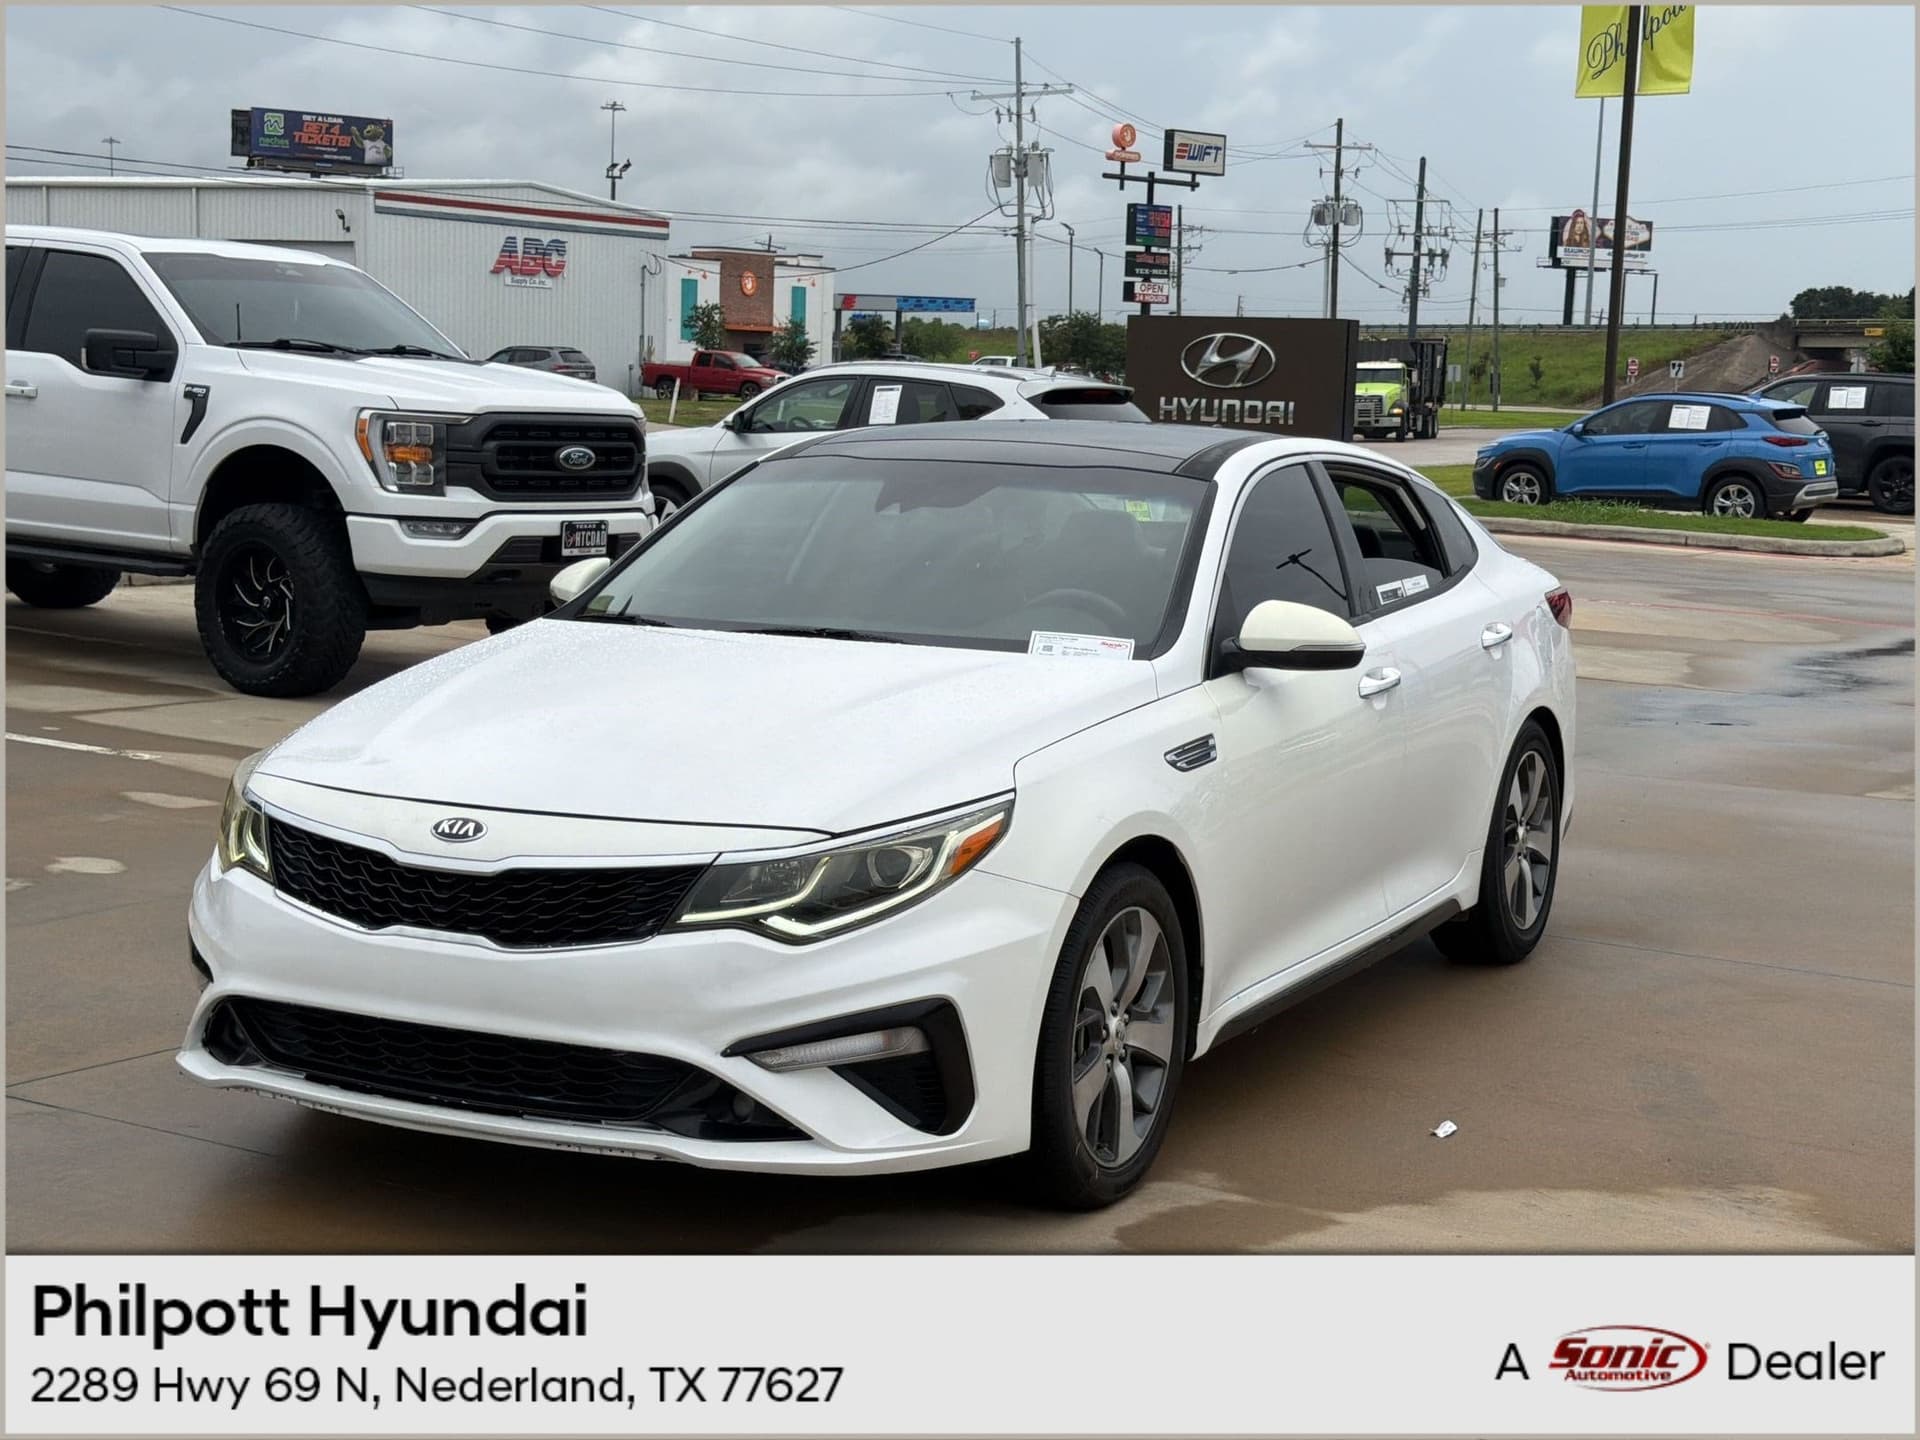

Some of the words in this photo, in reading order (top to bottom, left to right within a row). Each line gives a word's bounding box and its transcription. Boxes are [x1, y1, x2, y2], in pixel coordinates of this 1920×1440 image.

[304, 121, 329, 133] GET
[490, 235, 568, 278] ABC
[1139, 283, 1164, 293] OPEN
[1145, 294, 1167, 303] HOURS
[1159, 396, 1296, 426] HYUNDAI
[568, 452, 589, 465] Ford
[437, 820, 475, 836] KIA
